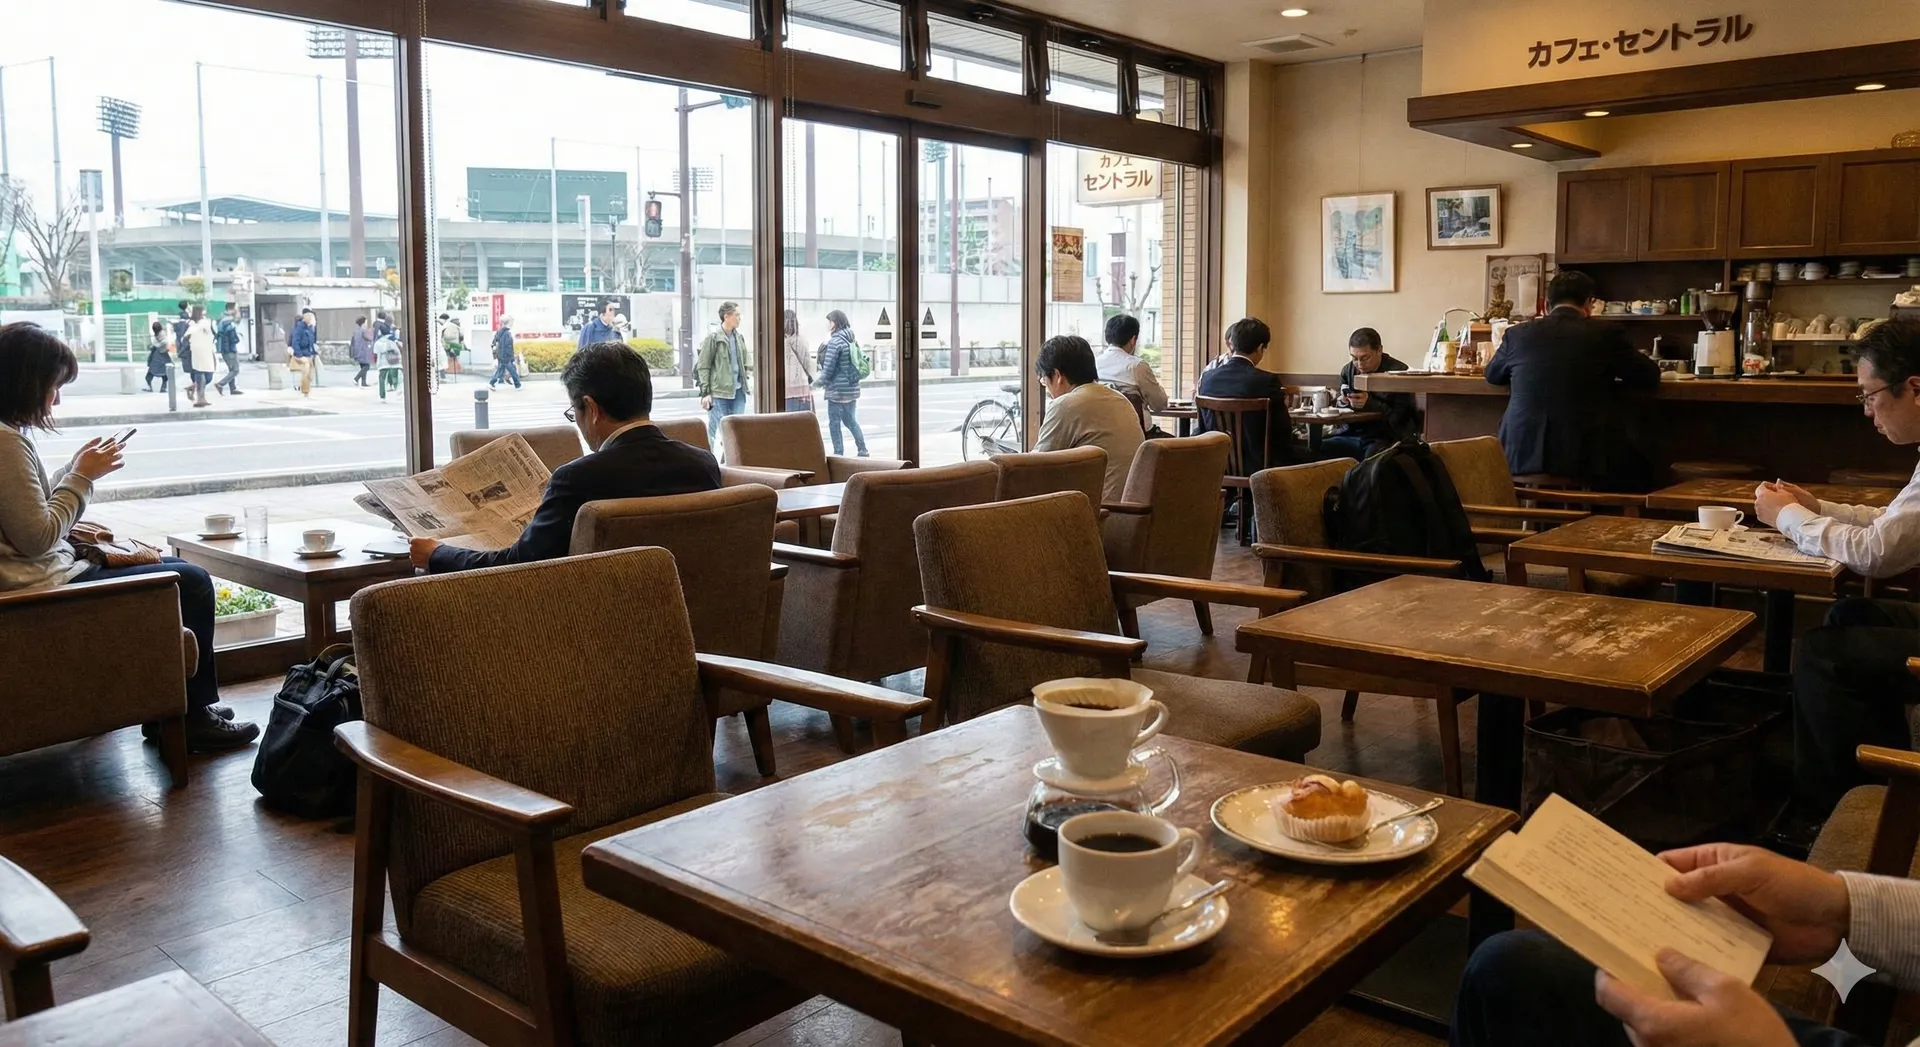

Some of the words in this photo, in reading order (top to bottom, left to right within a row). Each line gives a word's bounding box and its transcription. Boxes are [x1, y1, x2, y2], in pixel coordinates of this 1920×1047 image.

[1528, 14, 1753, 68] カフェ・セントラル
[1084, 170, 1153, 191] セントラル
